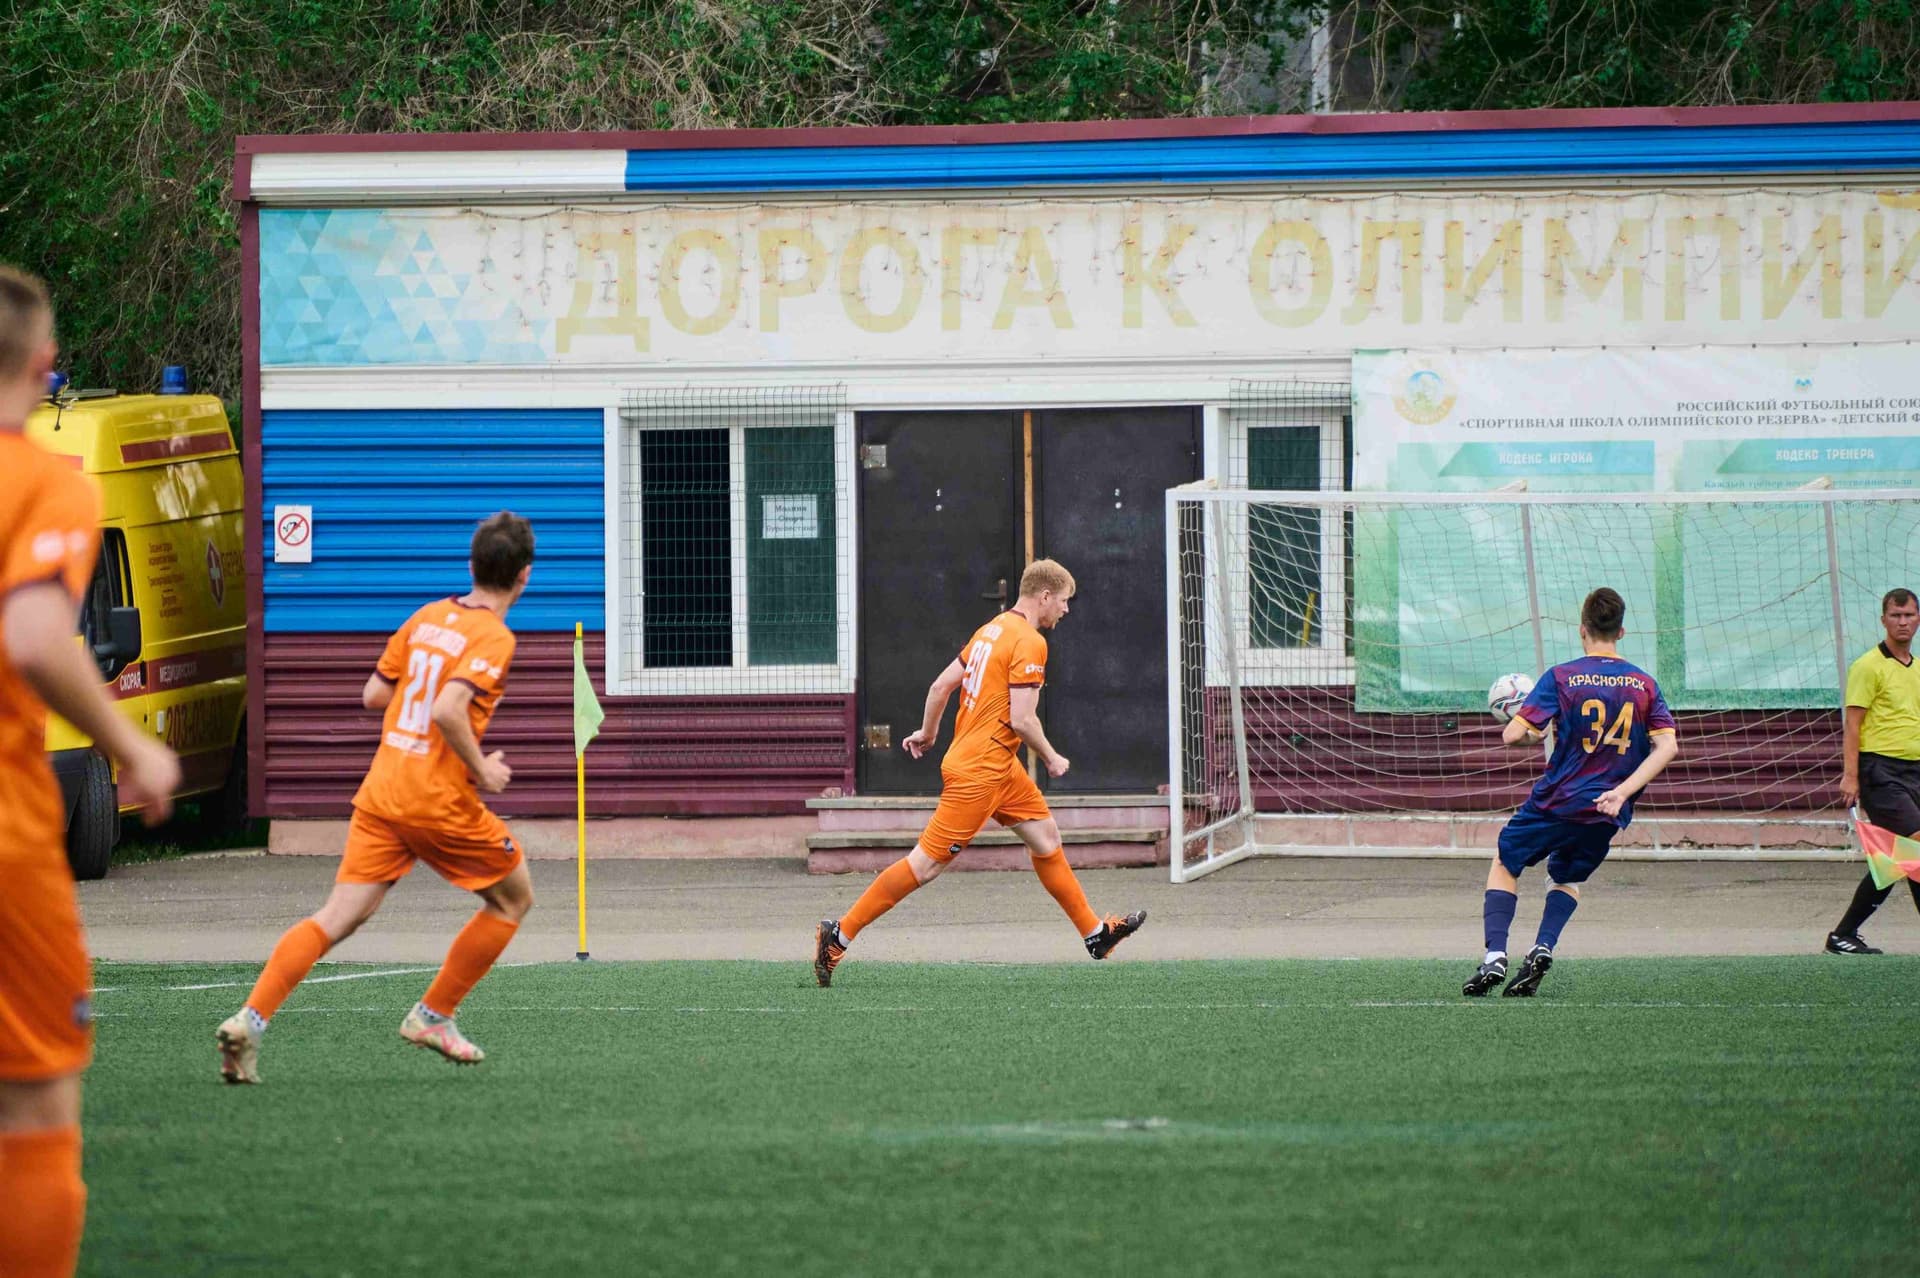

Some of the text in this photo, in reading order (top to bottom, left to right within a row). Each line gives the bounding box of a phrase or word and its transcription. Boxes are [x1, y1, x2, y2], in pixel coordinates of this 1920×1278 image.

[555, 223, 1074, 354] ДОРОГА
[1121, 222, 1200, 329] К
[1677, 399, 1777, 413] РОССИЙСКИЙ
[1781, 397, 1885, 411] ФУТБОЛЬНЫЙ
[1459, 417, 1565, 429] «СПОРТИВНАЯ
[1569, 416, 1624, 428] ШКОЛА
[1628, 413, 1753, 427] ОЛИМПИЙСКОГО
[1757, 414, 1827, 426] РЕЗЕРВА»
[1831, 411, 1907, 425] «ДЕТСКИЙ
[1499, 451, 1593, 466] КОДЕКС ИГРОКА
[1776, 448, 1875, 462] КОДЕКС ТРЕНЕРА
[1568, 674, 1645, 691] КРАСНОЯРСК
[396, 649, 444, 736] 21
[1581, 698, 1634, 756] 34
